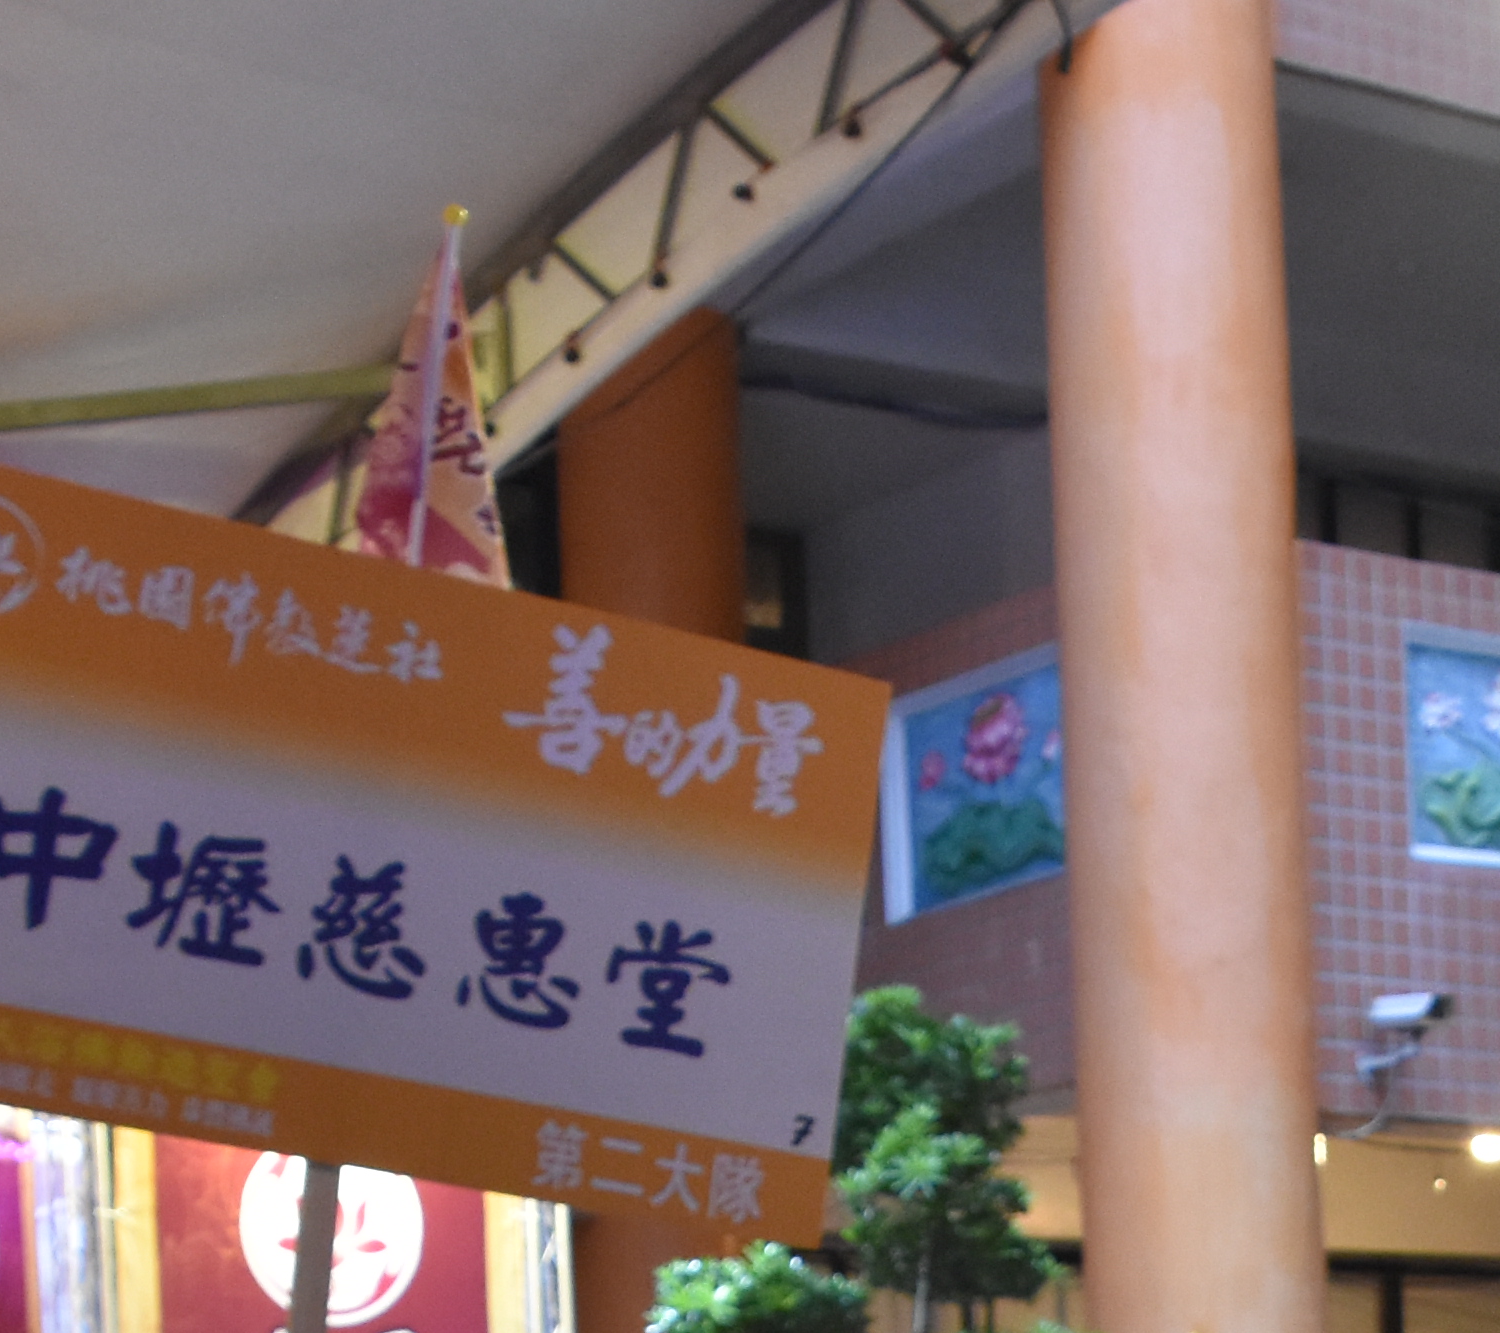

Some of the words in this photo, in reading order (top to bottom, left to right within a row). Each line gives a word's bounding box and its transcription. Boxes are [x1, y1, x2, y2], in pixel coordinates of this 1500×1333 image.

[502, 624, 825, 817] 善的力量
[531, 1119, 766, 1225] 第二大隊
